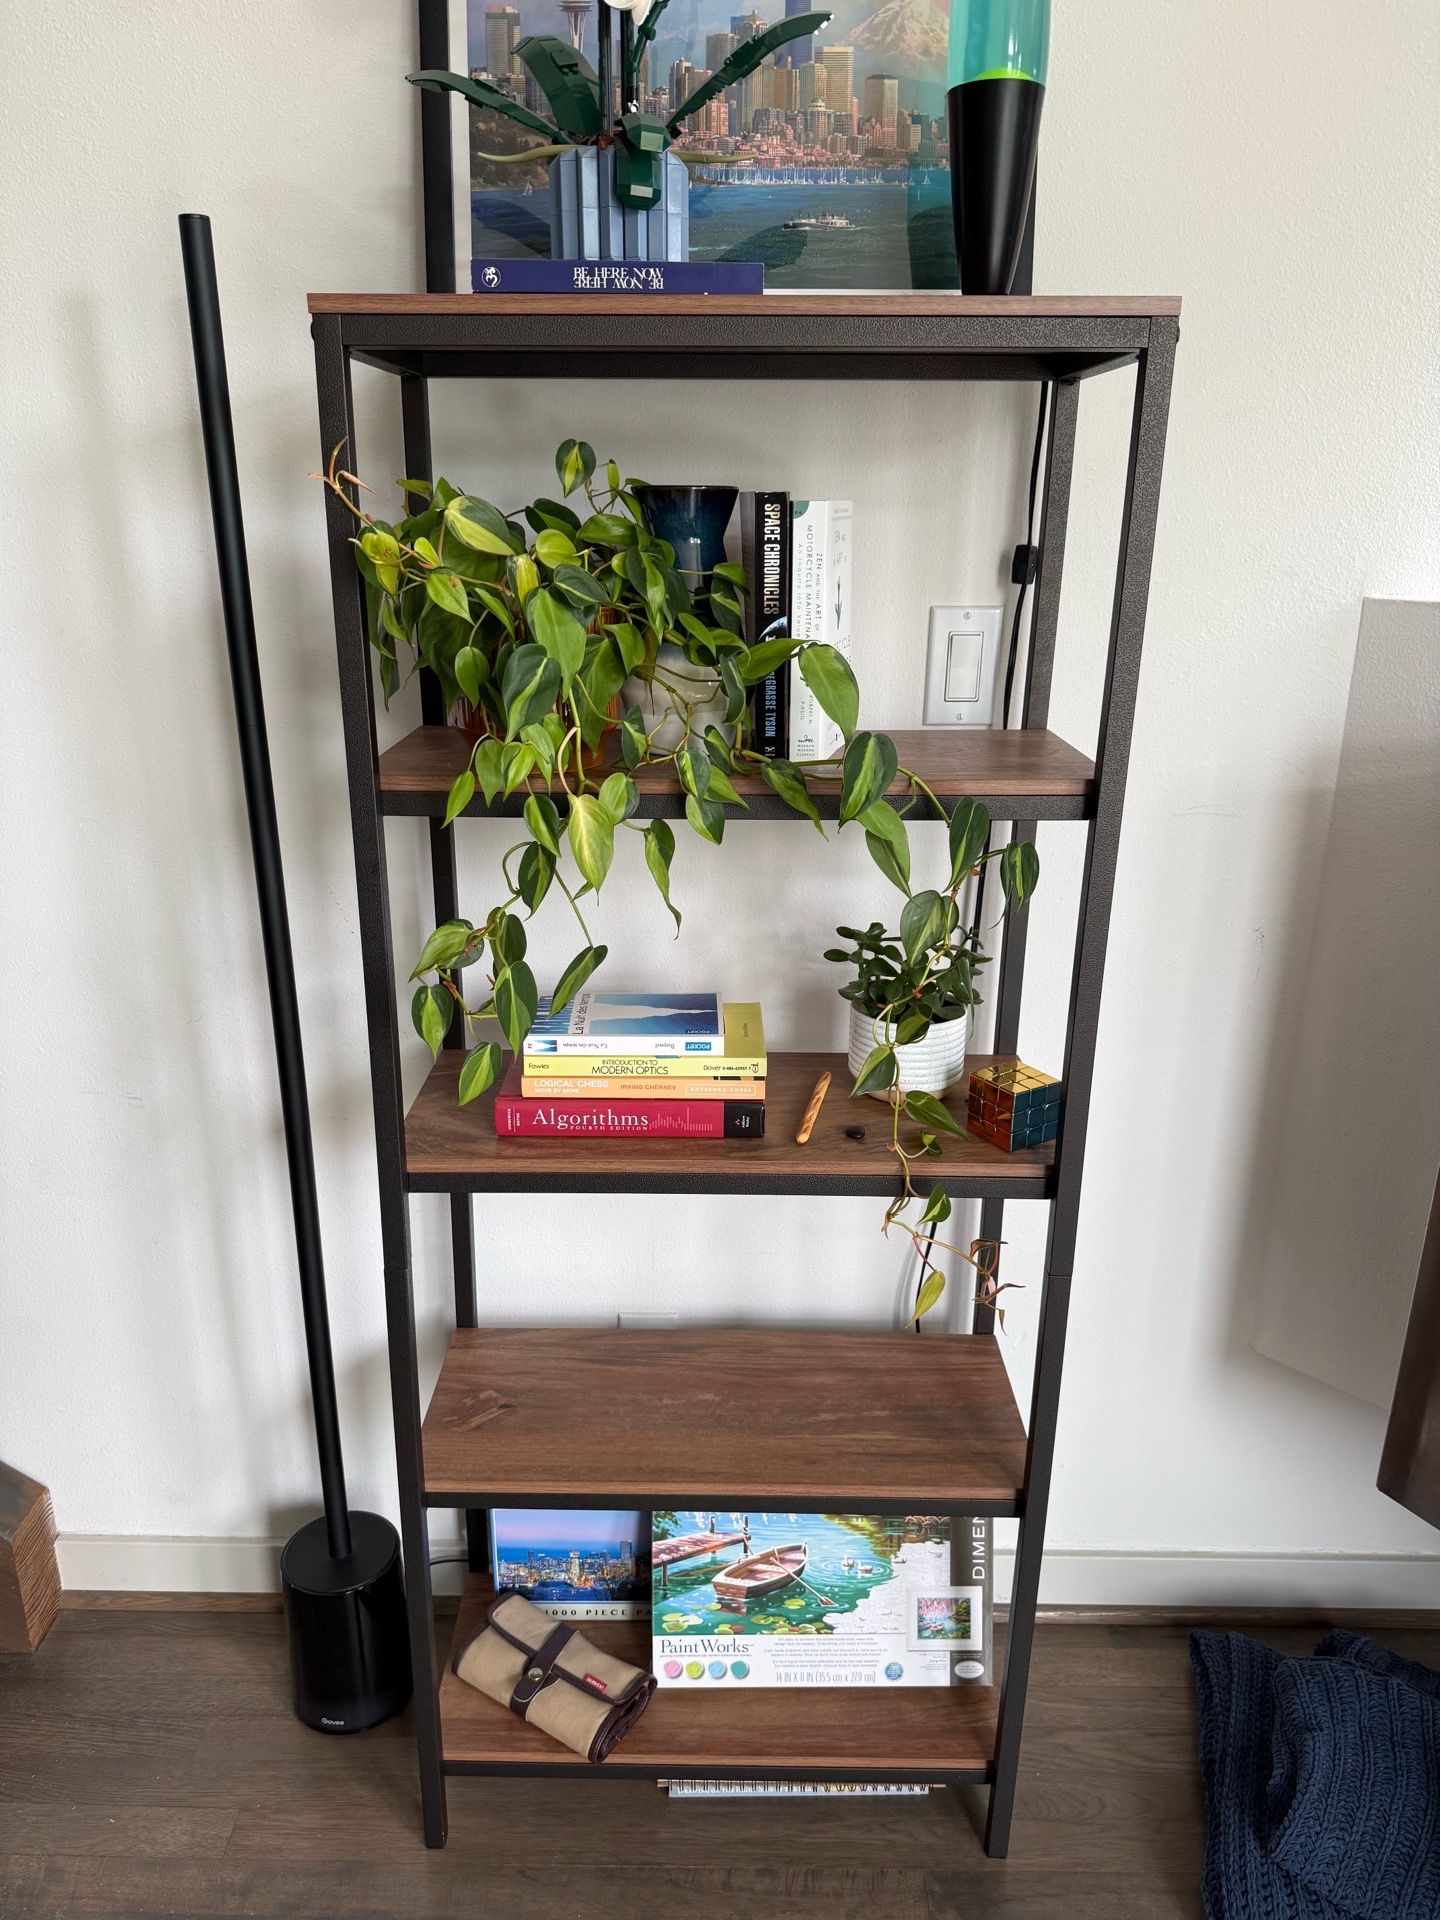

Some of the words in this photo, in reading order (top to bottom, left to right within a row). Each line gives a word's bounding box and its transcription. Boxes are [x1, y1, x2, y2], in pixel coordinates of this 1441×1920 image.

[574, 267, 590, 278] BE
[594, 267, 629, 279] HERE
[633, 267, 664, 279] NOW
[764, 504, 781, 541] SPACE
[805, 524, 814, 589] MOTORCYCLE
[815, 552, 823, 570] ZEN
[763, 543, 781, 615] CHRONICLES
[814, 603, 822, 620] ART
[765, 712, 776, 738] TYSON
[576, 1005, 588, 1015] des
[572, 1026, 584, 1035] La
[591, 1066, 634, 1075] MODERN
[634, 1066, 669, 1075] OPTICS
[534, 1080, 574, 1088] LOGICAL
[577, 1080, 609, 1088] CHESS
[532, 1108, 649, 1130] Algorithms
[586, 1608, 628, 1616] PIECE
[776, 1672, 782, 1682] 14
[784, 1672, 792, 1682] IN
[806, 1672, 814, 1682] IN
[832, 1674, 842, 1682] cm
[864, 1671, 876, 1684] cm)
[321, 1718, 345, 1726] Govee
